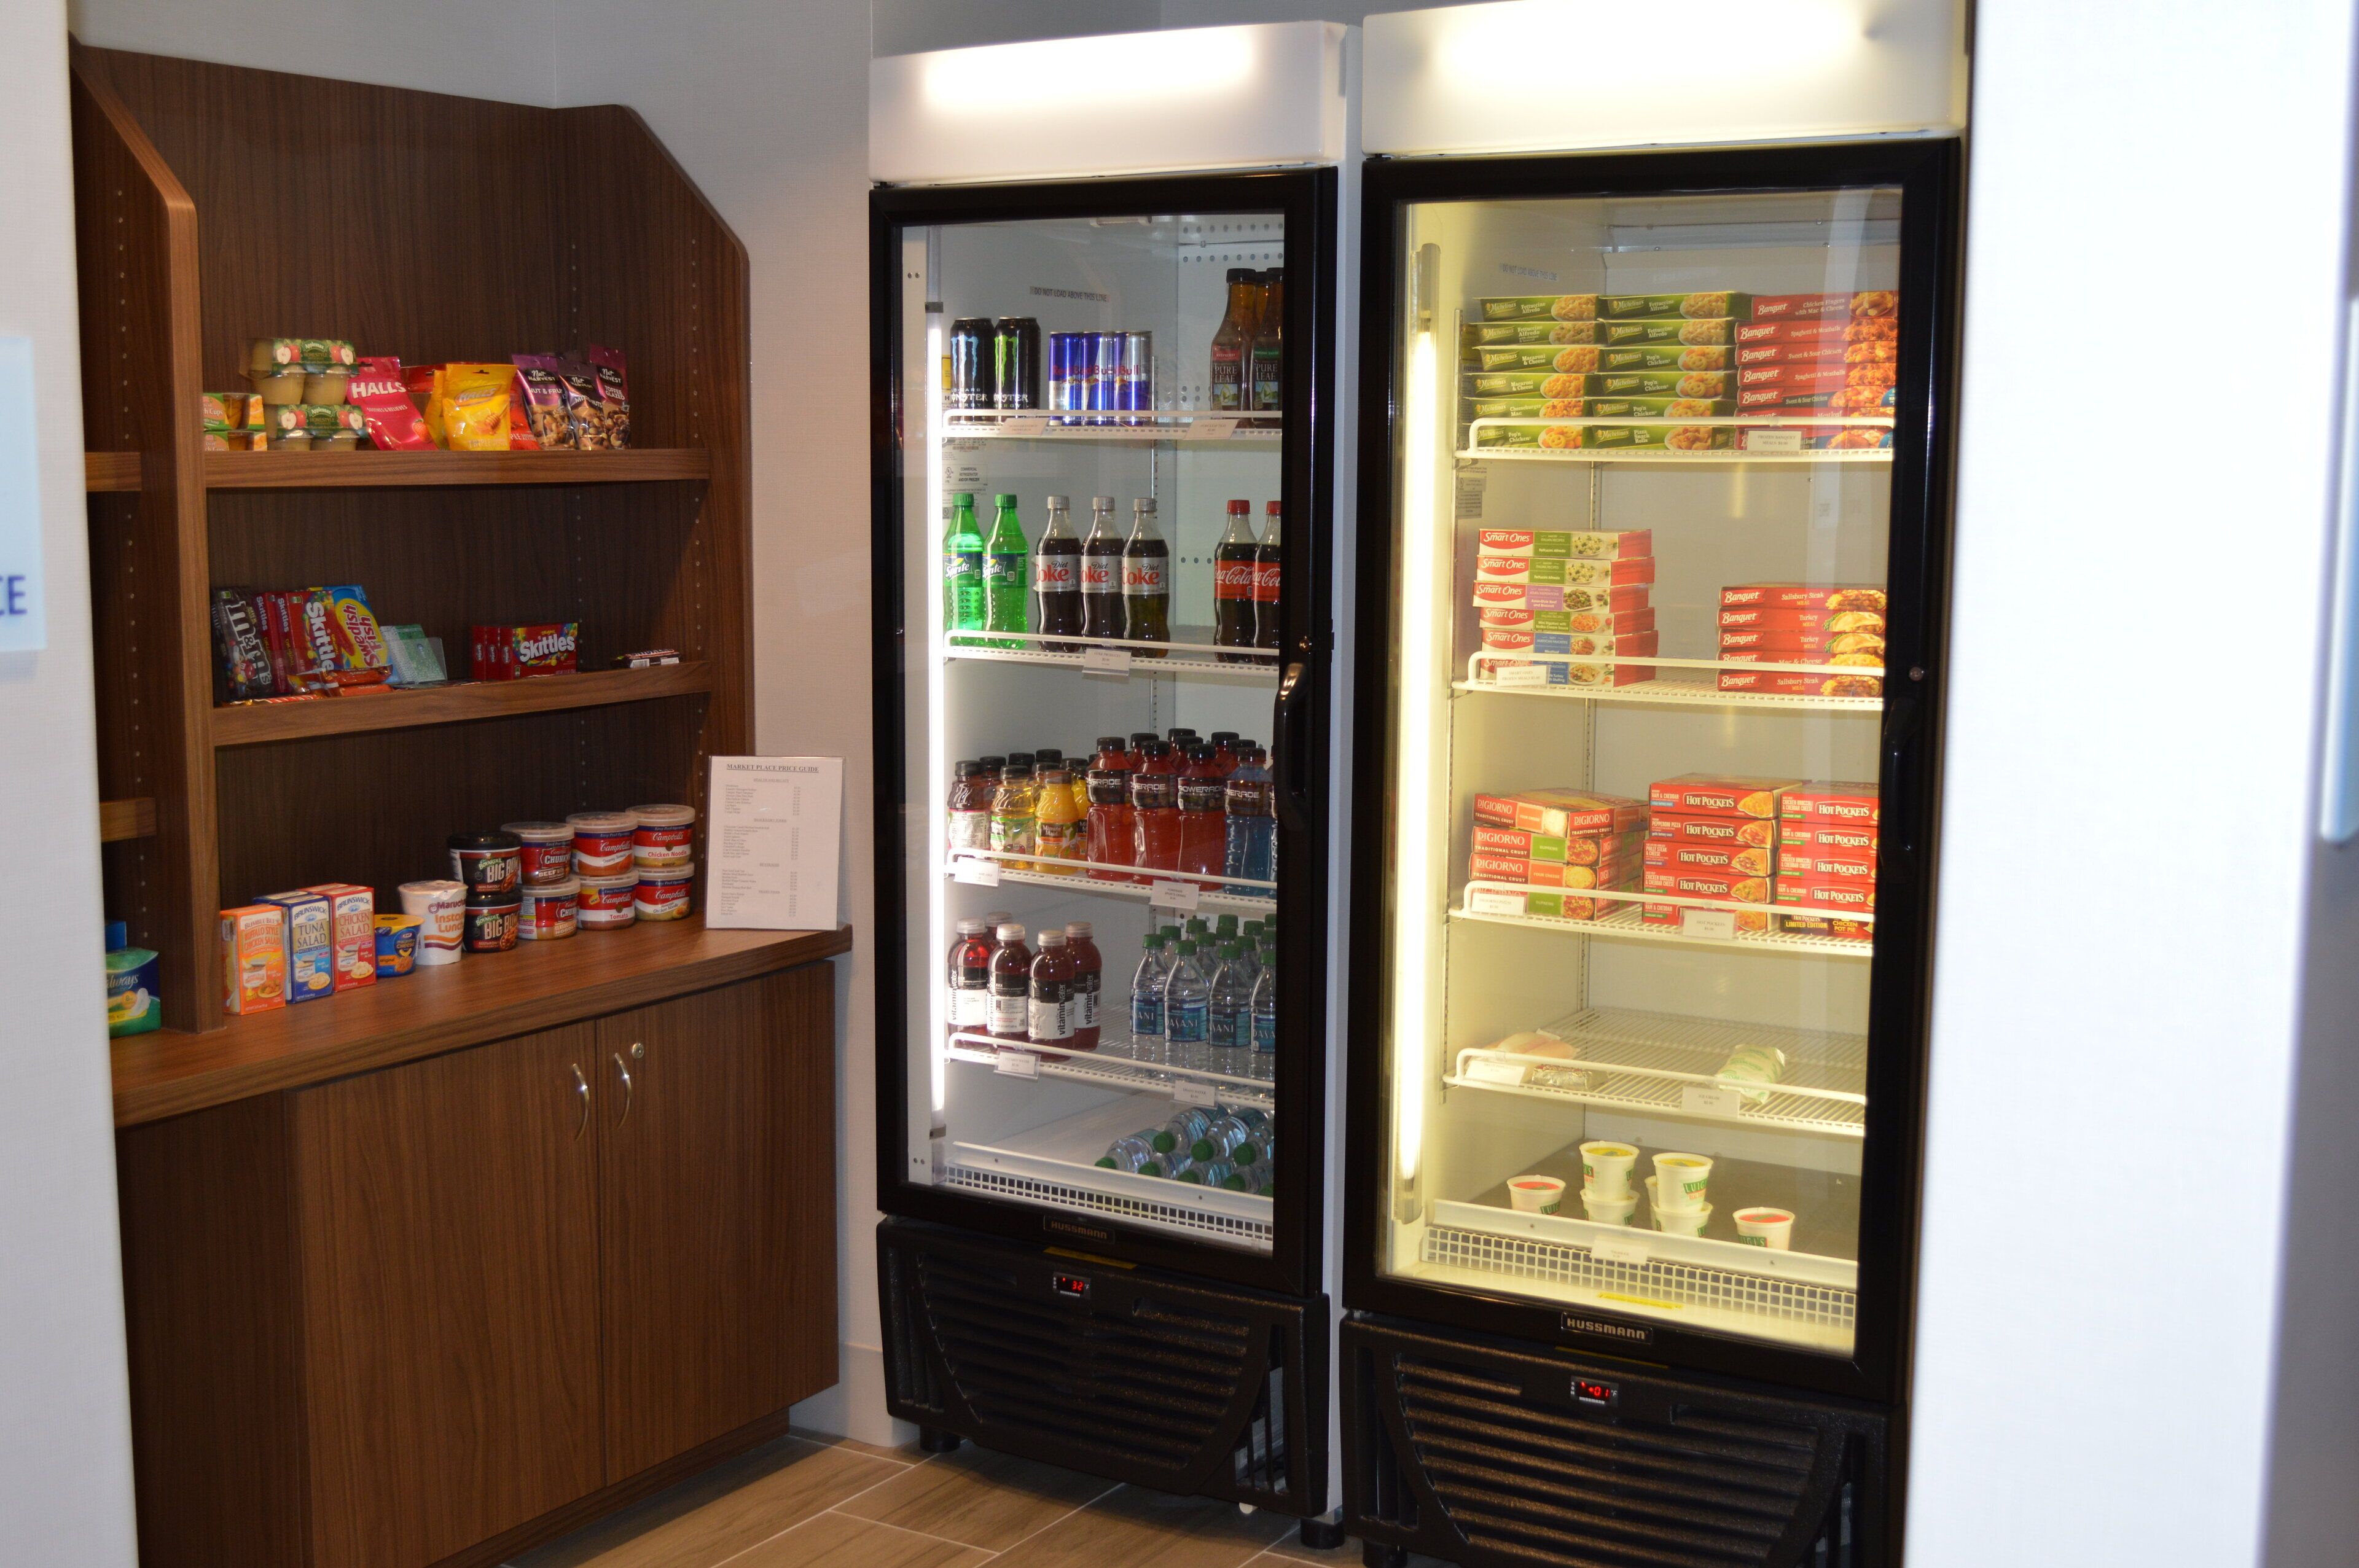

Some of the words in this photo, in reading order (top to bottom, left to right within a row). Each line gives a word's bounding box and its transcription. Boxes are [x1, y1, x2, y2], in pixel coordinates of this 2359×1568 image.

[1054, 289, 1066, 298] LOAD
[1068, 291, 1083, 300] ABOVE
[1084, 292, 1095, 301] THIS
[1803, 299, 1825, 308] Chicken
[1825, 297, 1845, 308] Fingers
[1740, 325, 1777, 340] Banquet
[1790, 328, 1812, 338] Spaghetti
[1741, 348, 1777, 362] Banquet
[1215, 366, 1238, 375] PURE
[1256, 364, 1278, 372] PURE
[599, 374, 621, 383] HARVEST
[1215, 375, 1235, 383] LEAF
[1256, 372, 1276, 381] LEAF
[1743, 369, 1780, 383] Banquet
[351, 381, 407, 399] HALLS
[459, 388, 497, 402] HALLS
[604, 386, 623, 396] TOFFEE
[606, 391, 625, 400] GLAZED
[1742, 391, 1778, 405] Banquet
[210, 409, 223, 418] Cups
[1484, 532, 1508, 542] Smart
[1509, 532, 1530, 543] Ones
[1051, 560, 1069, 569] Diet
[1091, 561, 1109, 570] Diet
[1141, 563, 1160, 571] Diet
[1481, 558, 1506, 569] Smart
[1506, 559, 1526, 569] Ones
[945, 563, 970, 579] Sprite
[1081, 566, 1109, 583] oke
[1477, 584, 1501, 595] Smart
[1502, 585, 1522, 595] Ones
[0, 575, 28, 617] E
[1724, 591, 1760, 603] Banquet
[256, 596, 268, 631] Skittles
[277, 598, 289, 633] Skittles
[306, 601, 335, 671] Skittle
[343, 604, 381, 668] Swedish
[359, 615, 385, 655] Fish
[1486, 632, 1511, 642] Smart
[1511, 633, 1532, 643] Ones
[520, 633, 576, 663] Skittles
[1178, 785, 1224, 794] POWERADE
[1477, 798, 1513, 815] DIGIORNO
[1686, 795, 1701, 806] HOT
[1702, 796, 1735, 808] POCKETS
[1575, 813, 1610, 825] DIGIORNO
[1686, 825, 1701, 835] HOT
[1702, 826, 1735, 837] POCKETS
[652, 832, 684, 843] Campbell's
[1478, 831, 1525, 846] DIGIORNO
[600, 841, 630, 853] Campbell's
[1475, 845, 1509, 854] TRADITIONAL
[544, 855, 569, 864] CHUNKY
[1681, 852, 1696, 862] HOT
[1696, 853, 1729, 864] POCKETS
[1476, 858, 1523, 873] DIGIORNO
[1680, 880, 1694, 890] HOT
[1696, 881, 1728, 893] POCKETS
[602, 893, 632, 905] Campbell's
[655, 889, 686, 900] Campbell's
[337, 896, 370, 911] BRUNSWICK
[294, 905, 327, 920] BRUNSWICK
[244, 918, 265, 930] BUMBLE
[338, 913, 370, 927] CHICKEN
[298, 921, 325, 932] TUNA
[340, 924, 370, 937] SALAD
[244, 927, 265, 940] BUFFALO
[265, 926, 279, 935] STYLE
[244, 938, 265, 950] CHICKEN
[265, 937, 280, 946] SALAD
[297, 933, 327, 948] SALAD
[1073, 1281, 1084, 1291] 32
[1567, 1317, 1646, 1340] HUSSMANN
